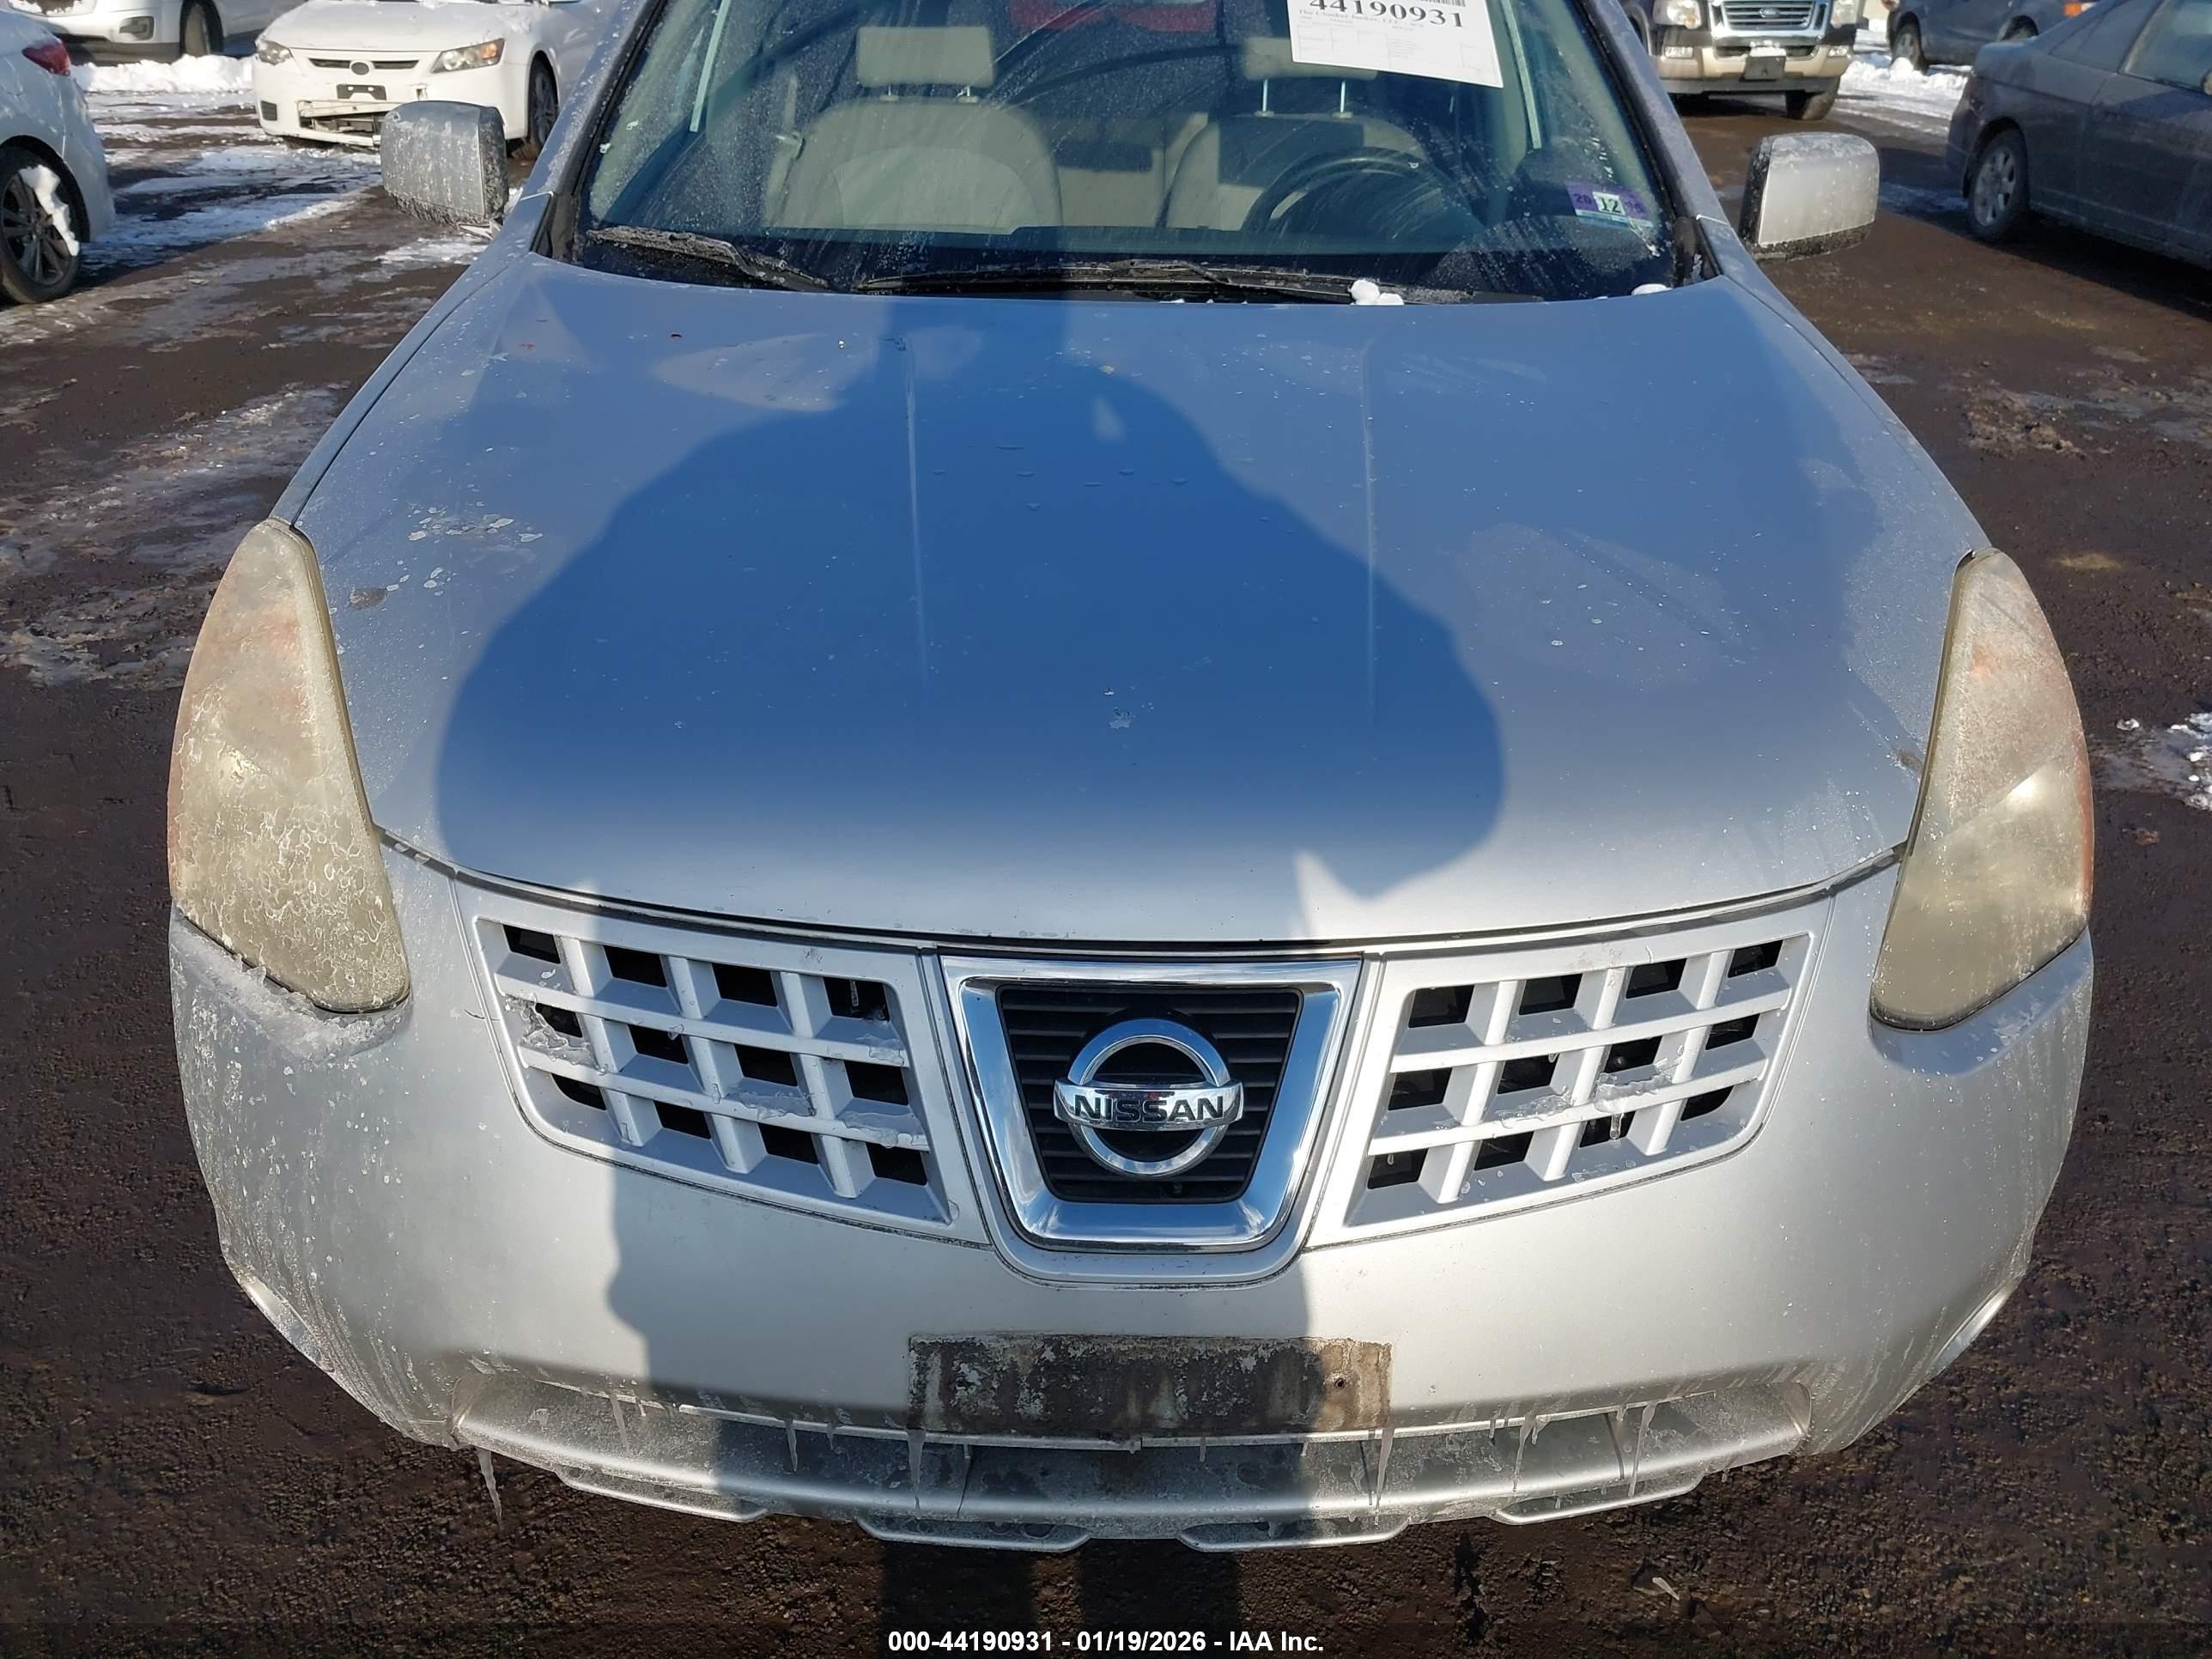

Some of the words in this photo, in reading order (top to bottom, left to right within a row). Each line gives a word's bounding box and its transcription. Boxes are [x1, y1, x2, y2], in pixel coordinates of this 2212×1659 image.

[1310, 0, 1463, 27] 44190931
[1599, 197, 1622, 214] 12
[1074, 1094, 1224, 1123] NISSAN
